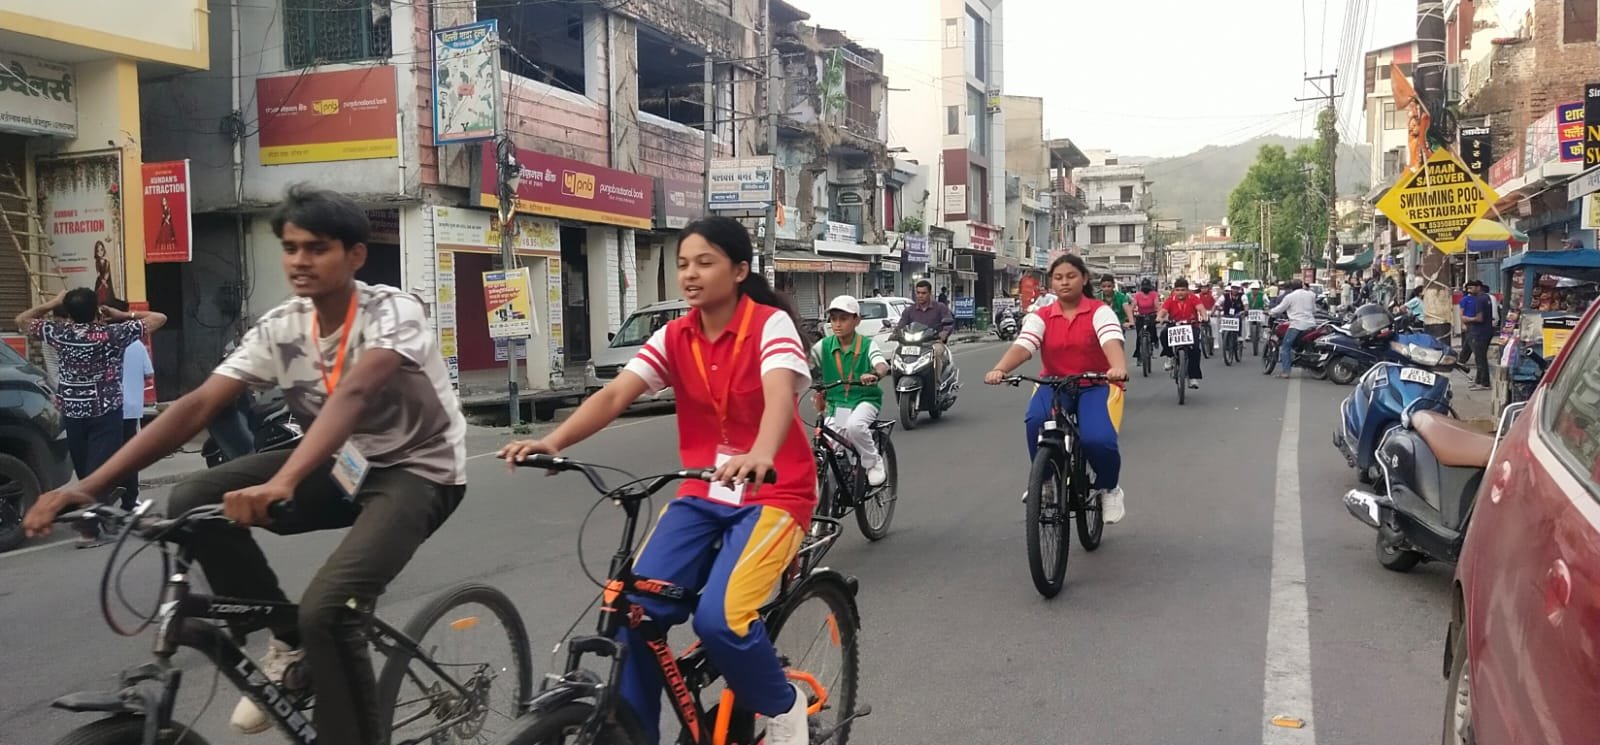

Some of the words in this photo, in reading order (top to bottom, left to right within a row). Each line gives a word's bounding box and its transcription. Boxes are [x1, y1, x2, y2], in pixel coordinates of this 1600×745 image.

[322, 102, 338, 113] pnb
[1426, 163, 1456, 176] MAAN
[1416, 172, 1465, 187] SAROVER
[144, 182, 186, 195] ATTRACTION
[577, 180, 595, 193] pnb
[1400, 188, 1454, 209] SWIMMING
[1457, 186, 1484, 203] POOL
[1409, 203, 1477, 220] RESTAURANT
[54, 220, 105, 234] ATTRACTION
[1169, 328, 1186, 337] SAVE
[1169, 335, 1193, 345] FUEL
